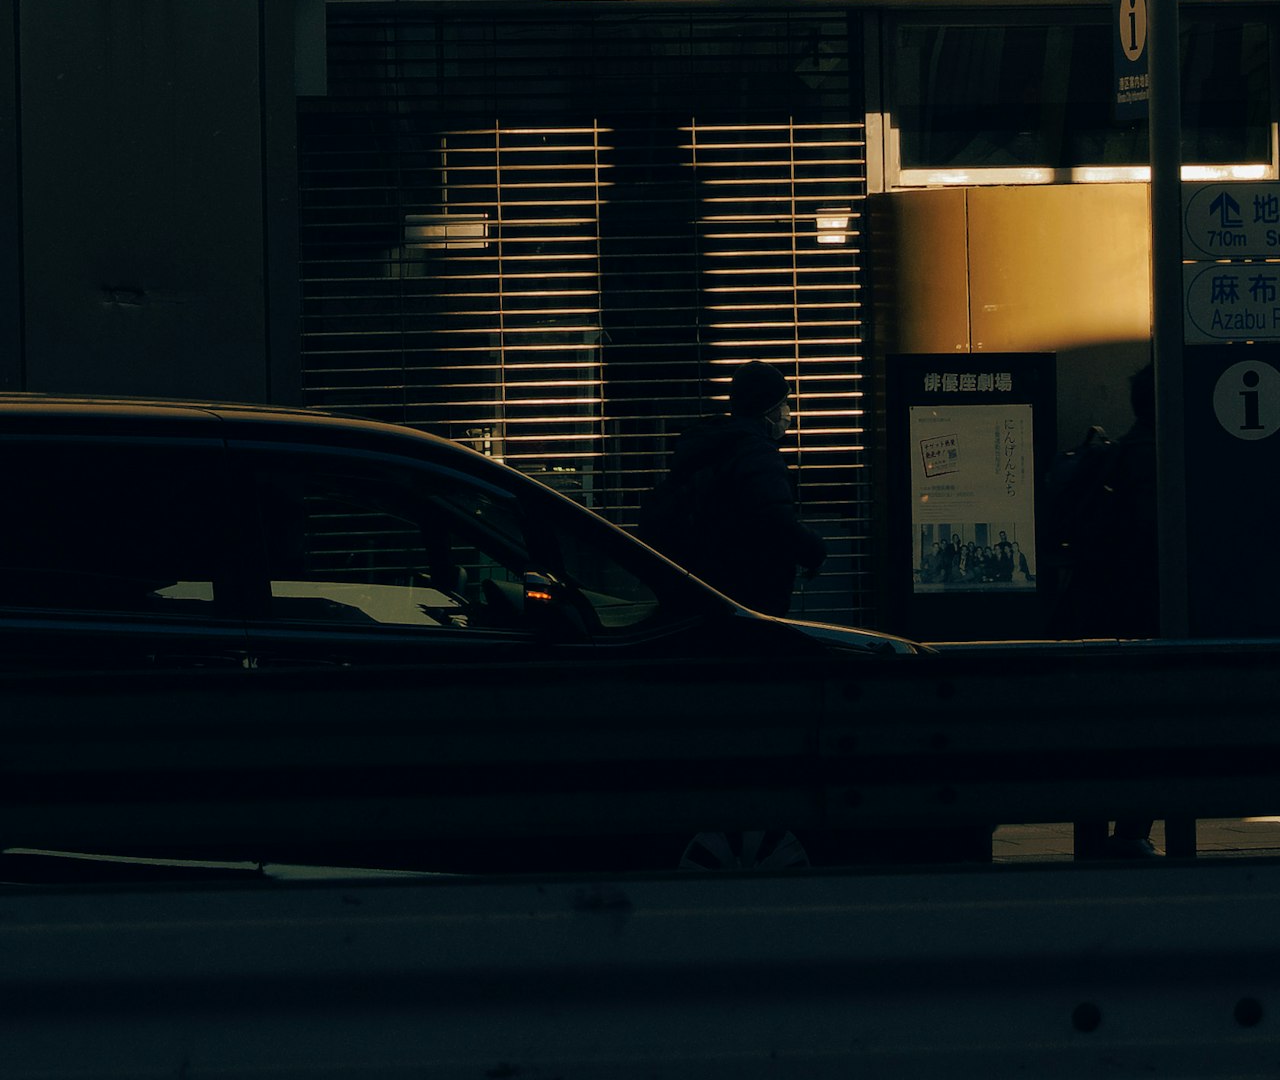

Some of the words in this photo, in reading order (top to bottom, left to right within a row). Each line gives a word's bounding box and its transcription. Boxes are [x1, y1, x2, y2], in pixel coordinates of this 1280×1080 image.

[1207, 230, 1247, 248] 710m
[1211, 308, 1266, 330] Azabu
[924, 373, 1013, 392] 俳優座劇場
[1003, 418, 1017, 497] にんげんたち
